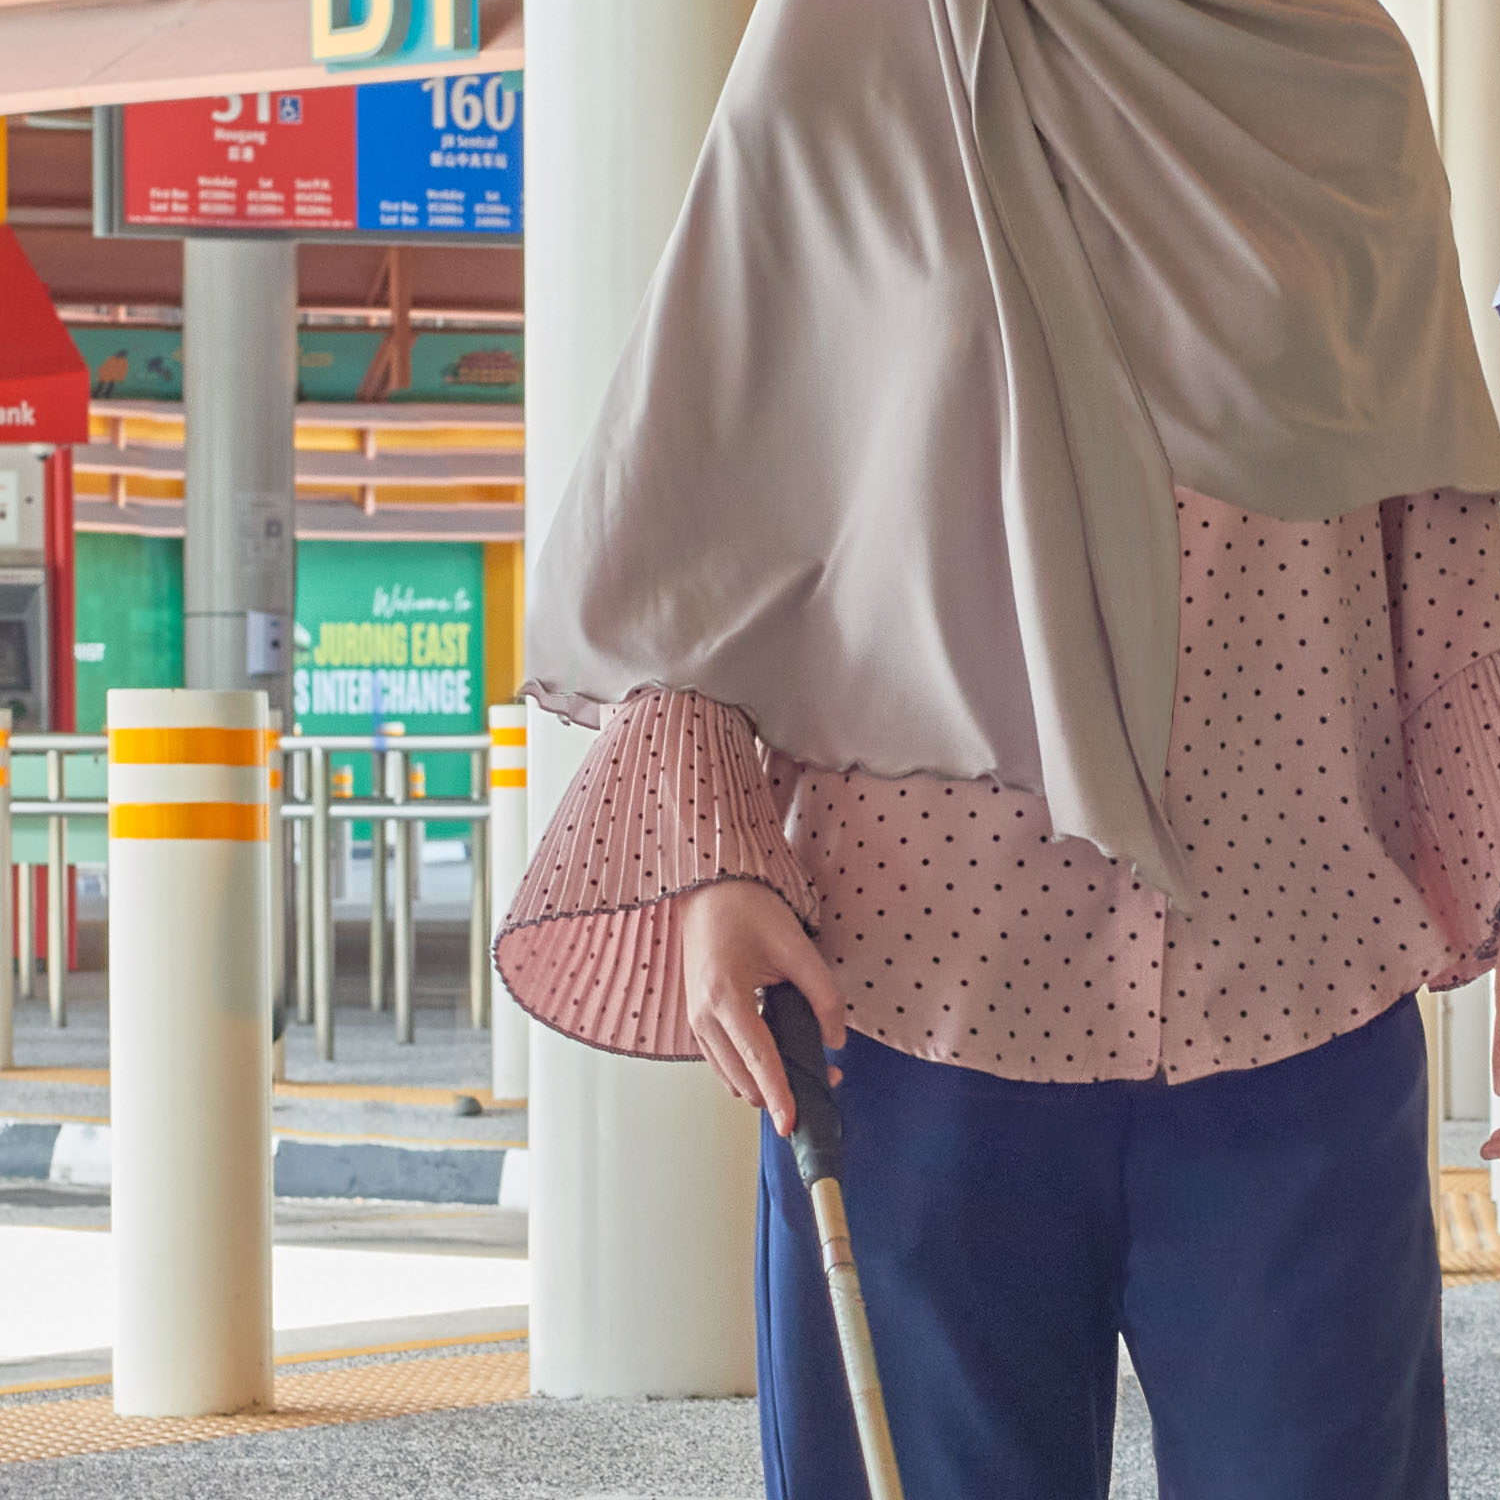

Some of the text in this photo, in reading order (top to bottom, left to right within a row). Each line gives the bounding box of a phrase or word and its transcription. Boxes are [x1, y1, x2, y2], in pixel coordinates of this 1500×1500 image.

[422, 75, 516, 131] 160
[313, 622, 471, 666] JURONG EAST
[312, 669, 472, 714] INTERCHANGE
